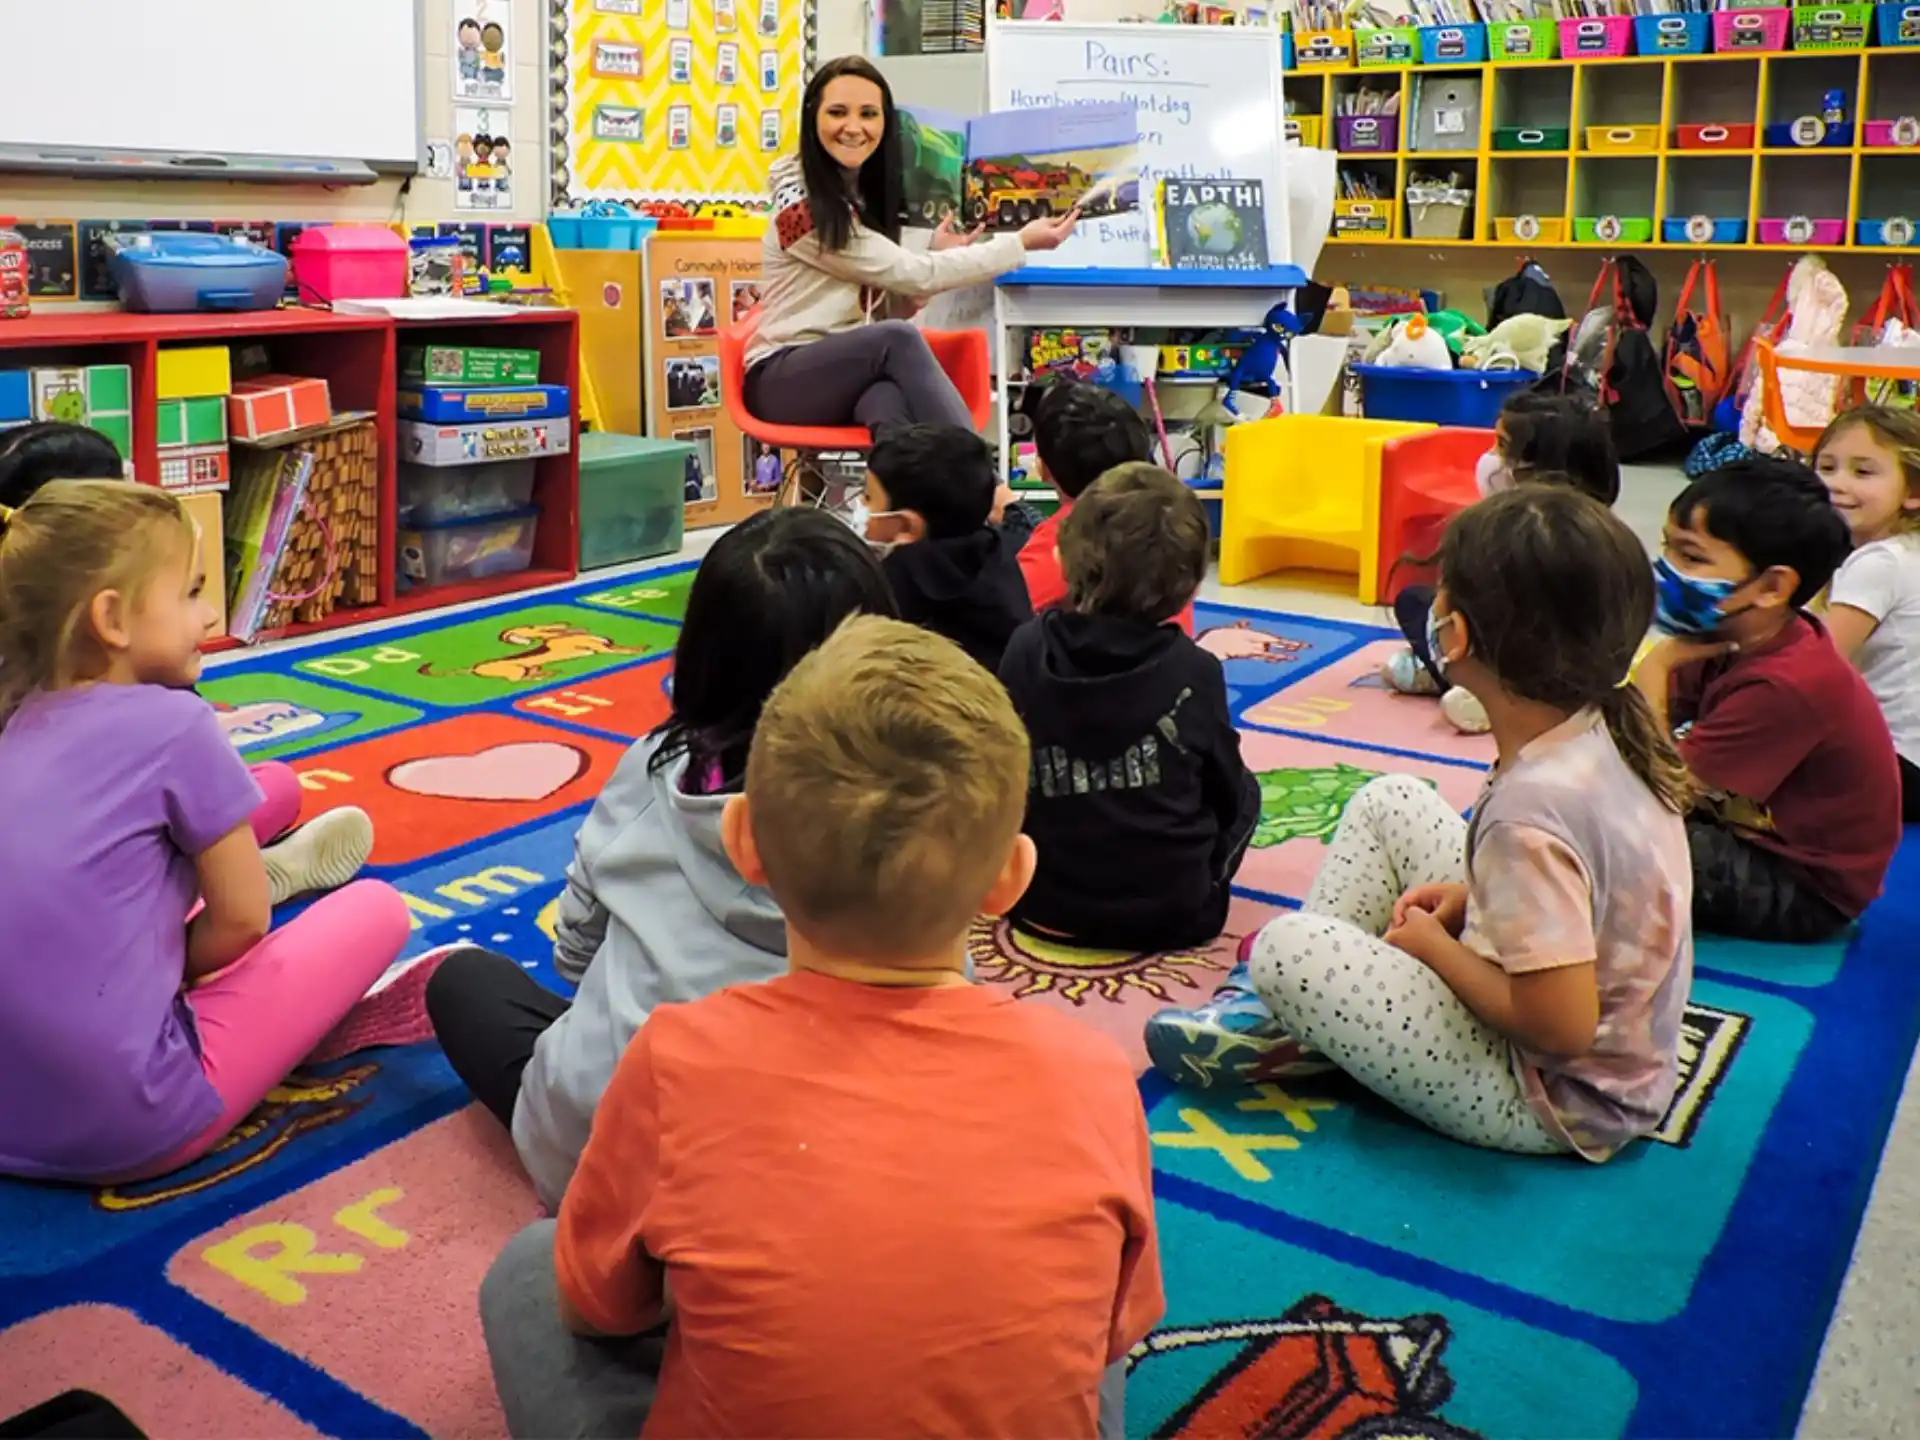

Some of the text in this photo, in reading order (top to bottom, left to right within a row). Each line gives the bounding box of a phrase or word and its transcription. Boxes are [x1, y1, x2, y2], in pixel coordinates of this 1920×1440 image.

[1086, 40, 1170, 76] Pairs:
[477, 107, 490, 132] 3
[1167, 185, 1262, 208] EARTH!
[25, 238, 62, 250] ecess
[674, 258, 727, 275] Community
[305, 646, 421, 676] Dd
[525, 691, 615, 716] Ii
[1268, 696, 1352, 727] Uu
[1151, 1085, 1337, 1181] Xx
[200, 1187, 409, 1305] Rr
